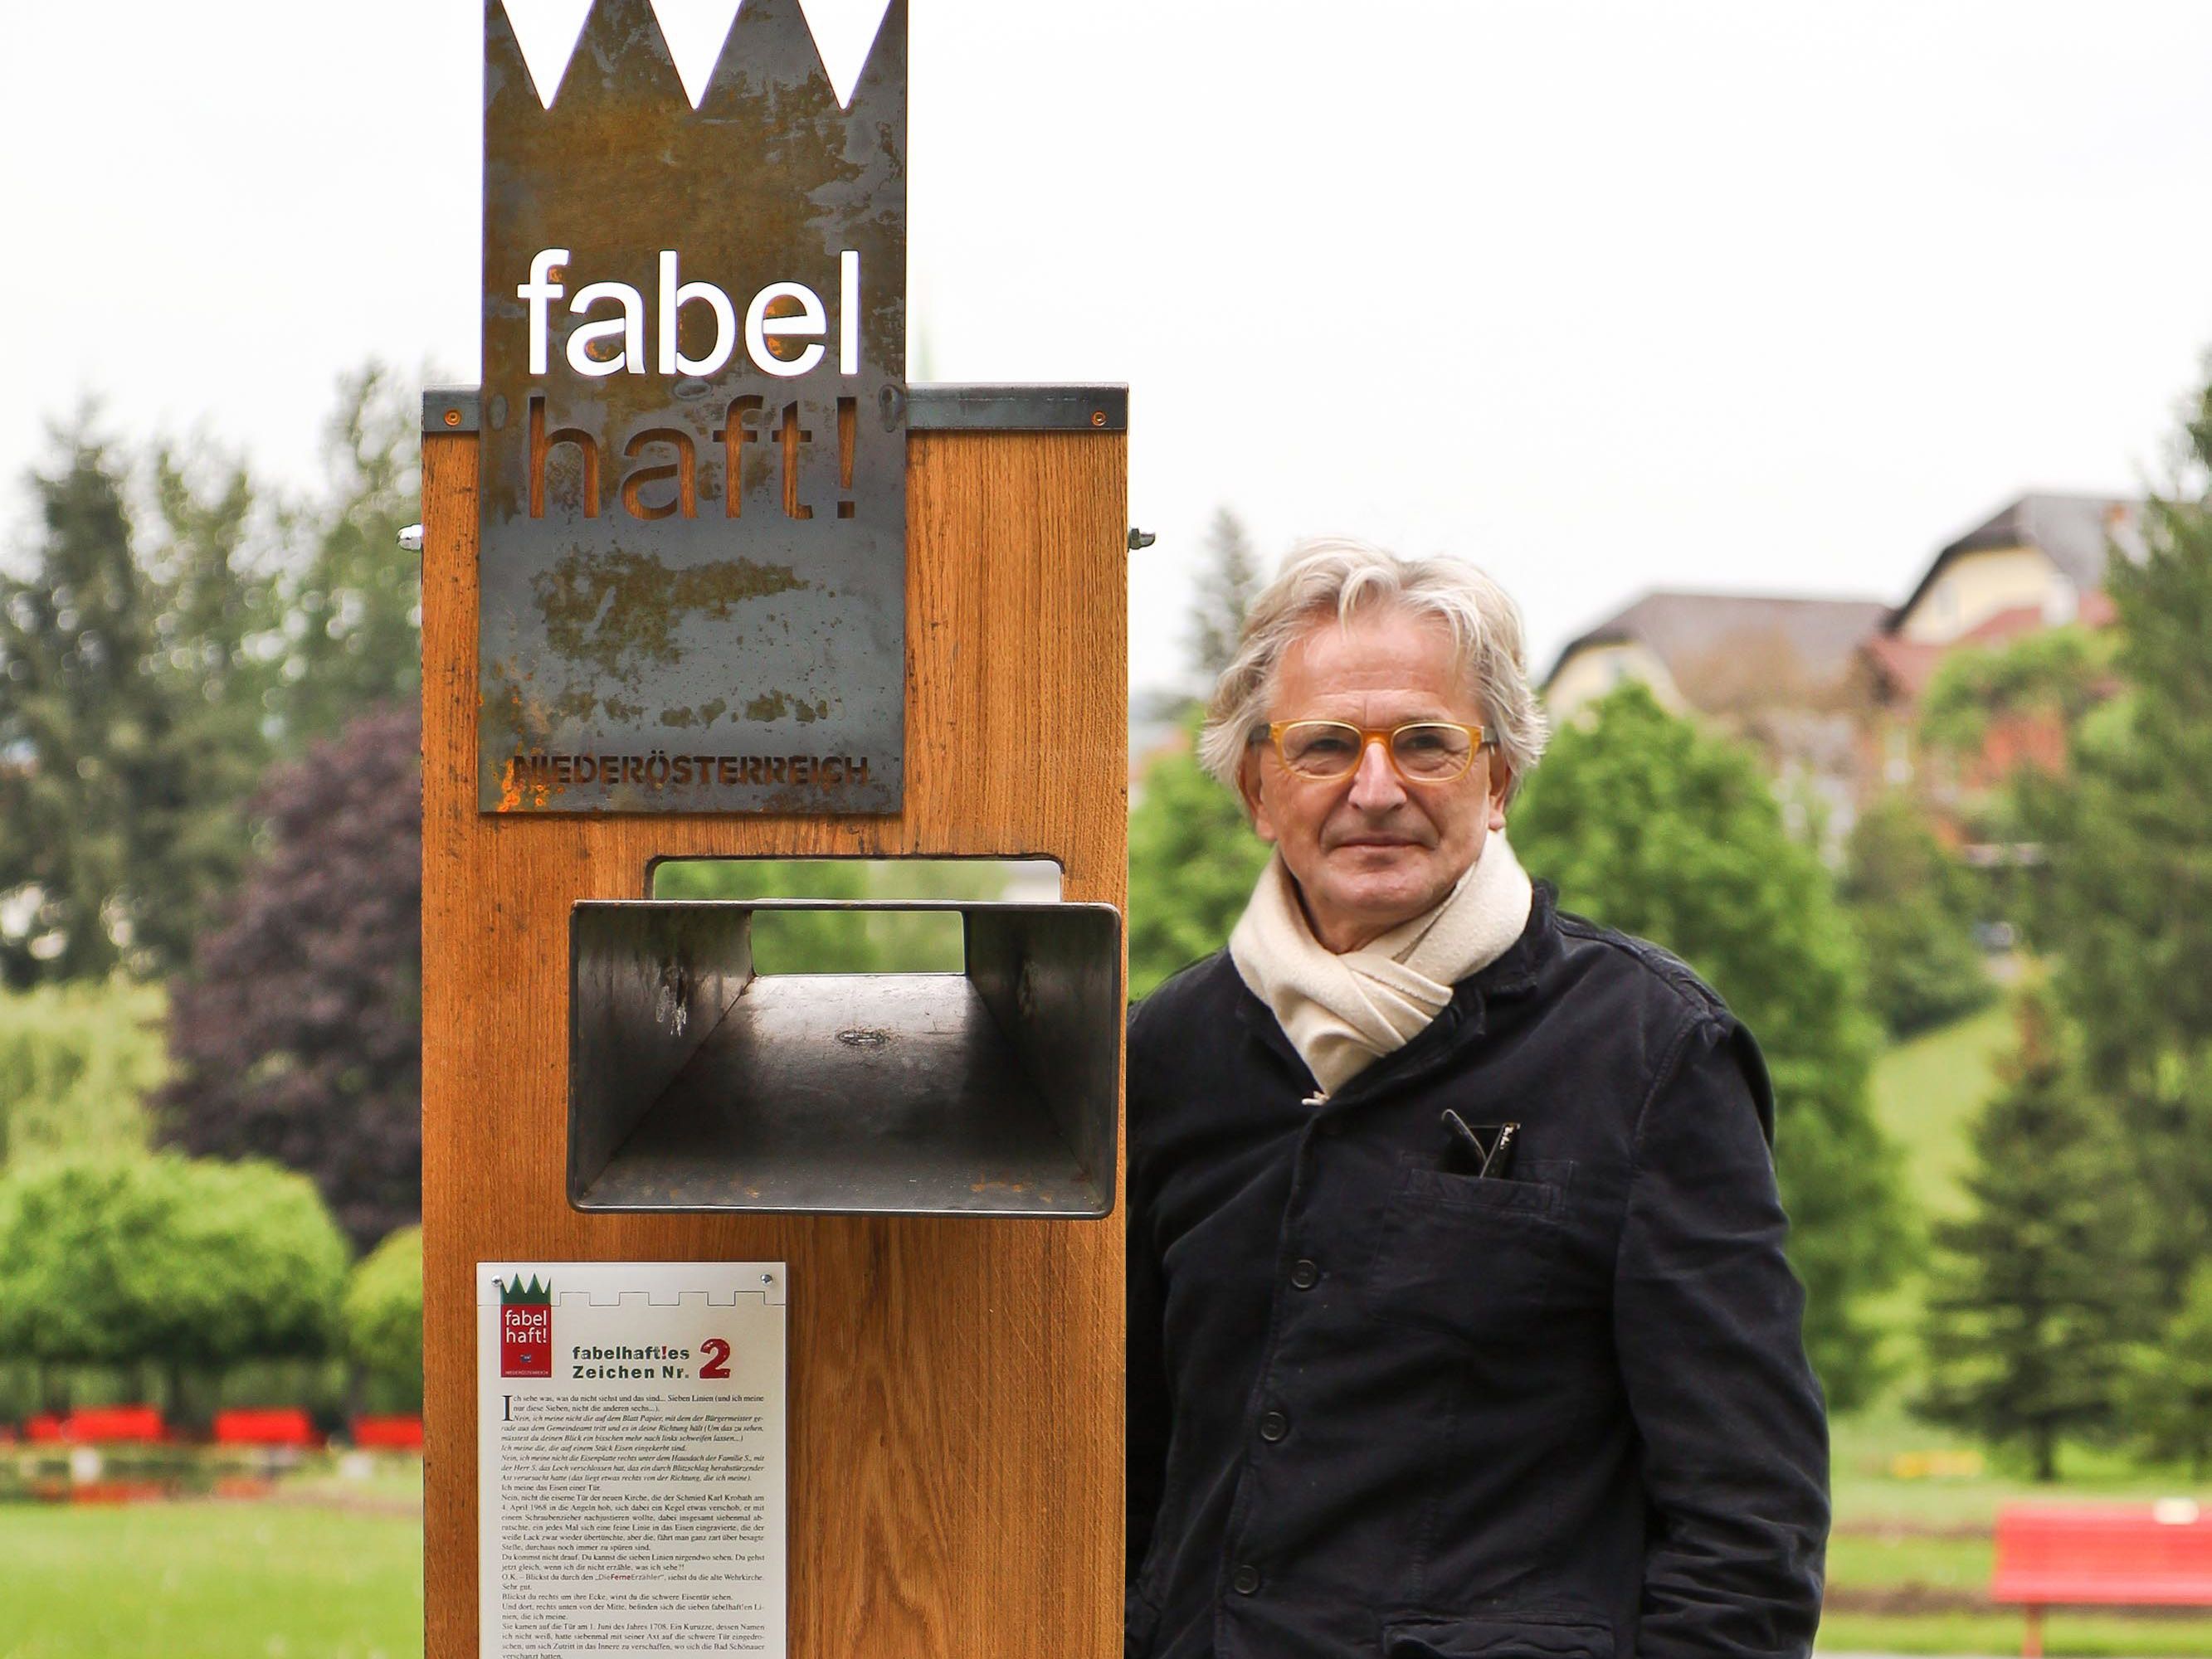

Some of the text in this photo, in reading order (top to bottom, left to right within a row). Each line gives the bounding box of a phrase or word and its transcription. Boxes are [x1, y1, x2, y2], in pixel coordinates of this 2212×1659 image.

[517, 250, 860, 377] fabel
[528, 394, 857, 520] haft!
[512, 750, 870, 785] NIEDERÖSTERREICH
[505, 1309, 547, 1326] fabel
[505, 1326, 547, 1343] haft!
[572, 1345, 690, 1360] fabelhaft!es
[572, 1337, 731, 1379] Zeichen Nr. 2
